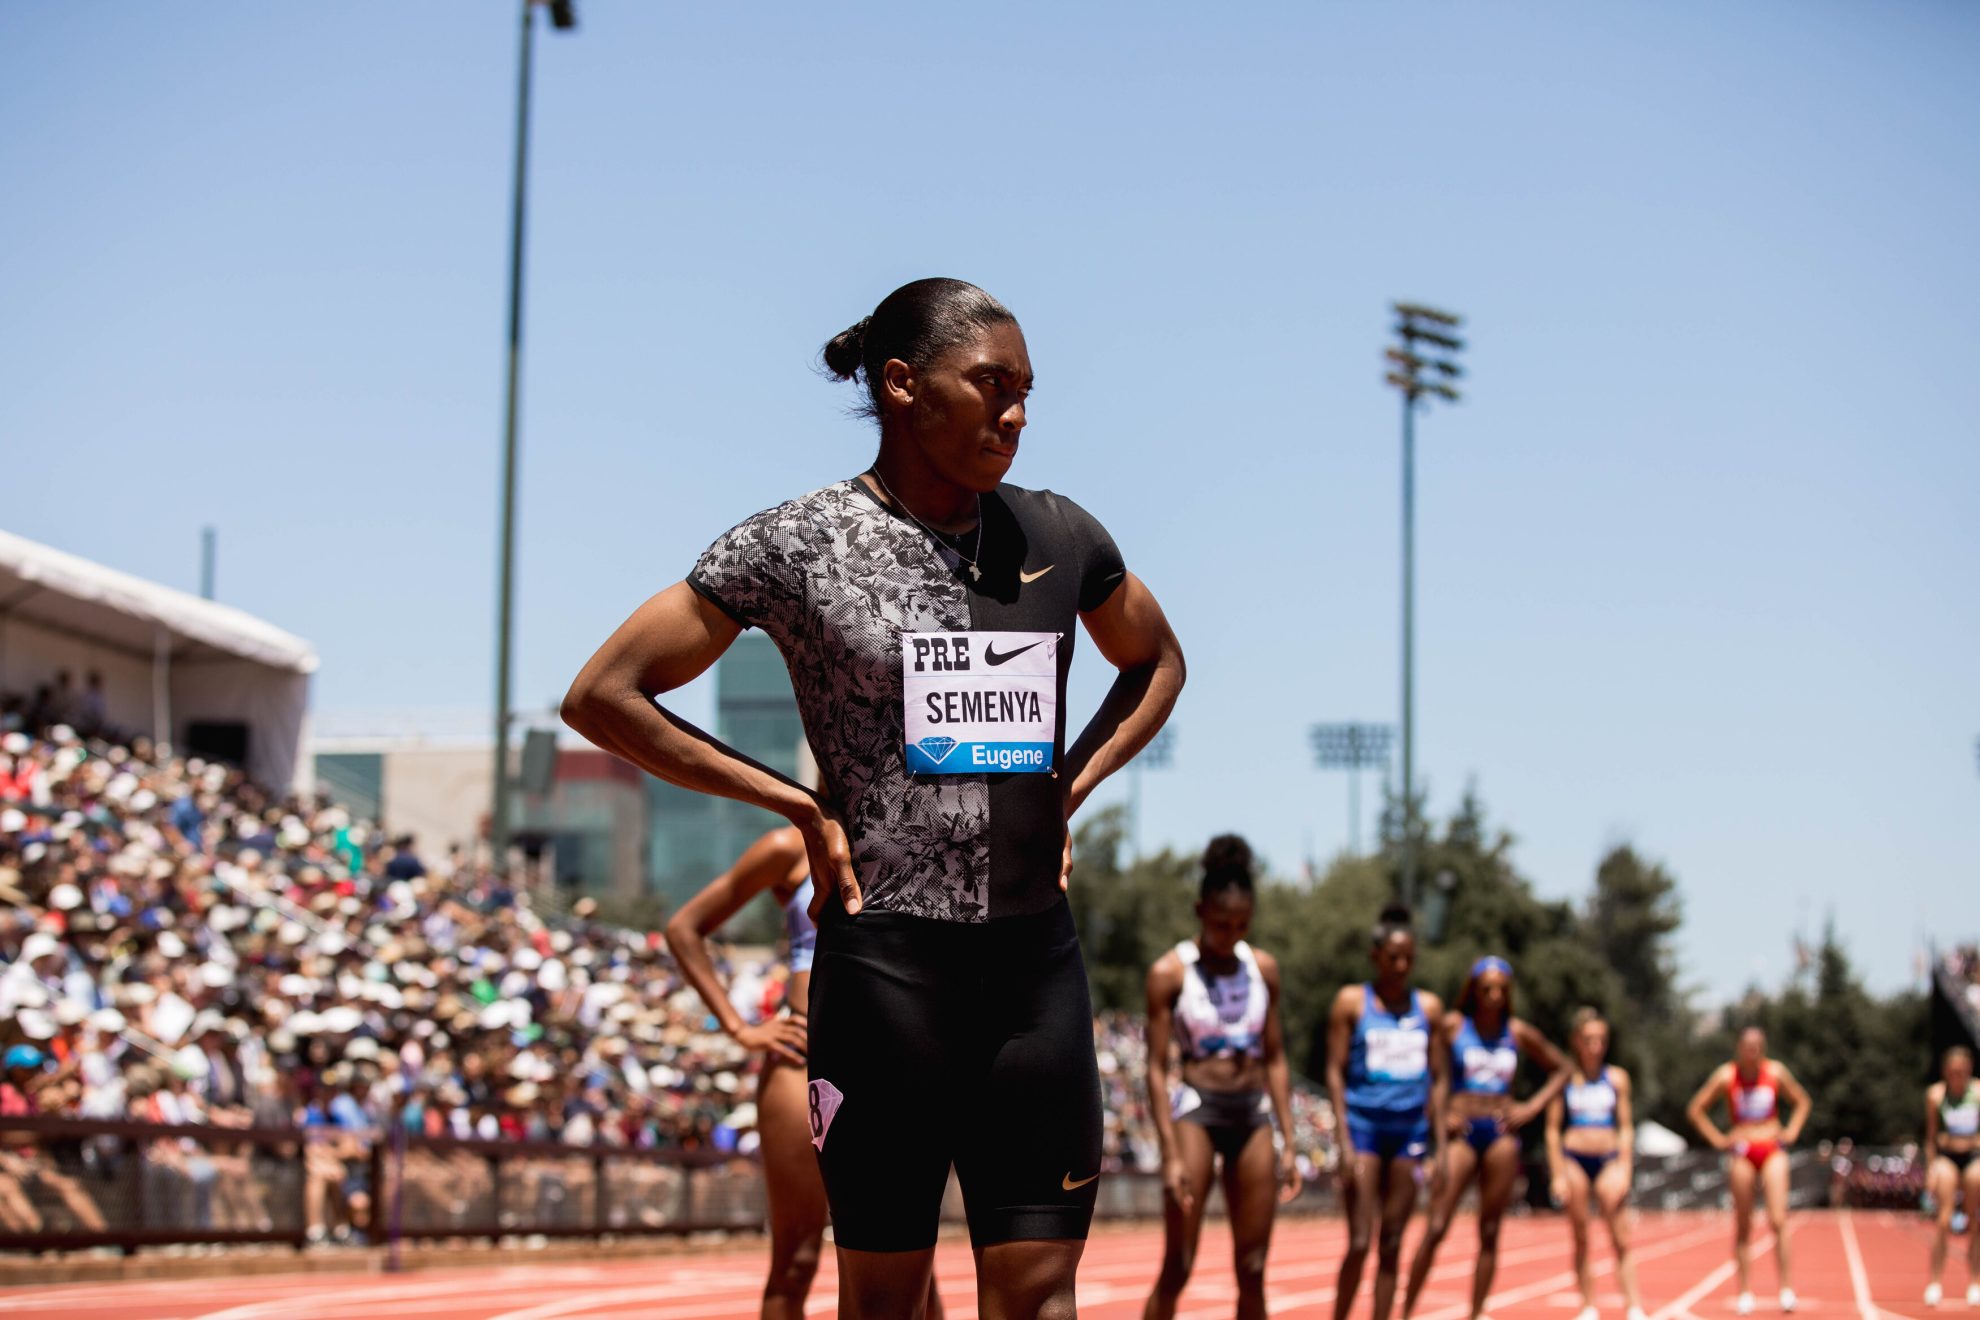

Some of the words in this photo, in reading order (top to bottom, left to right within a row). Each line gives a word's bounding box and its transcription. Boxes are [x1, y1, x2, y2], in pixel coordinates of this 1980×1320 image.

[912, 637, 971, 672] PRE
[926, 691, 1042, 724] SEMENYA
[971, 745, 1043, 769] Eugene
[808, 1082, 824, 1137] 8
